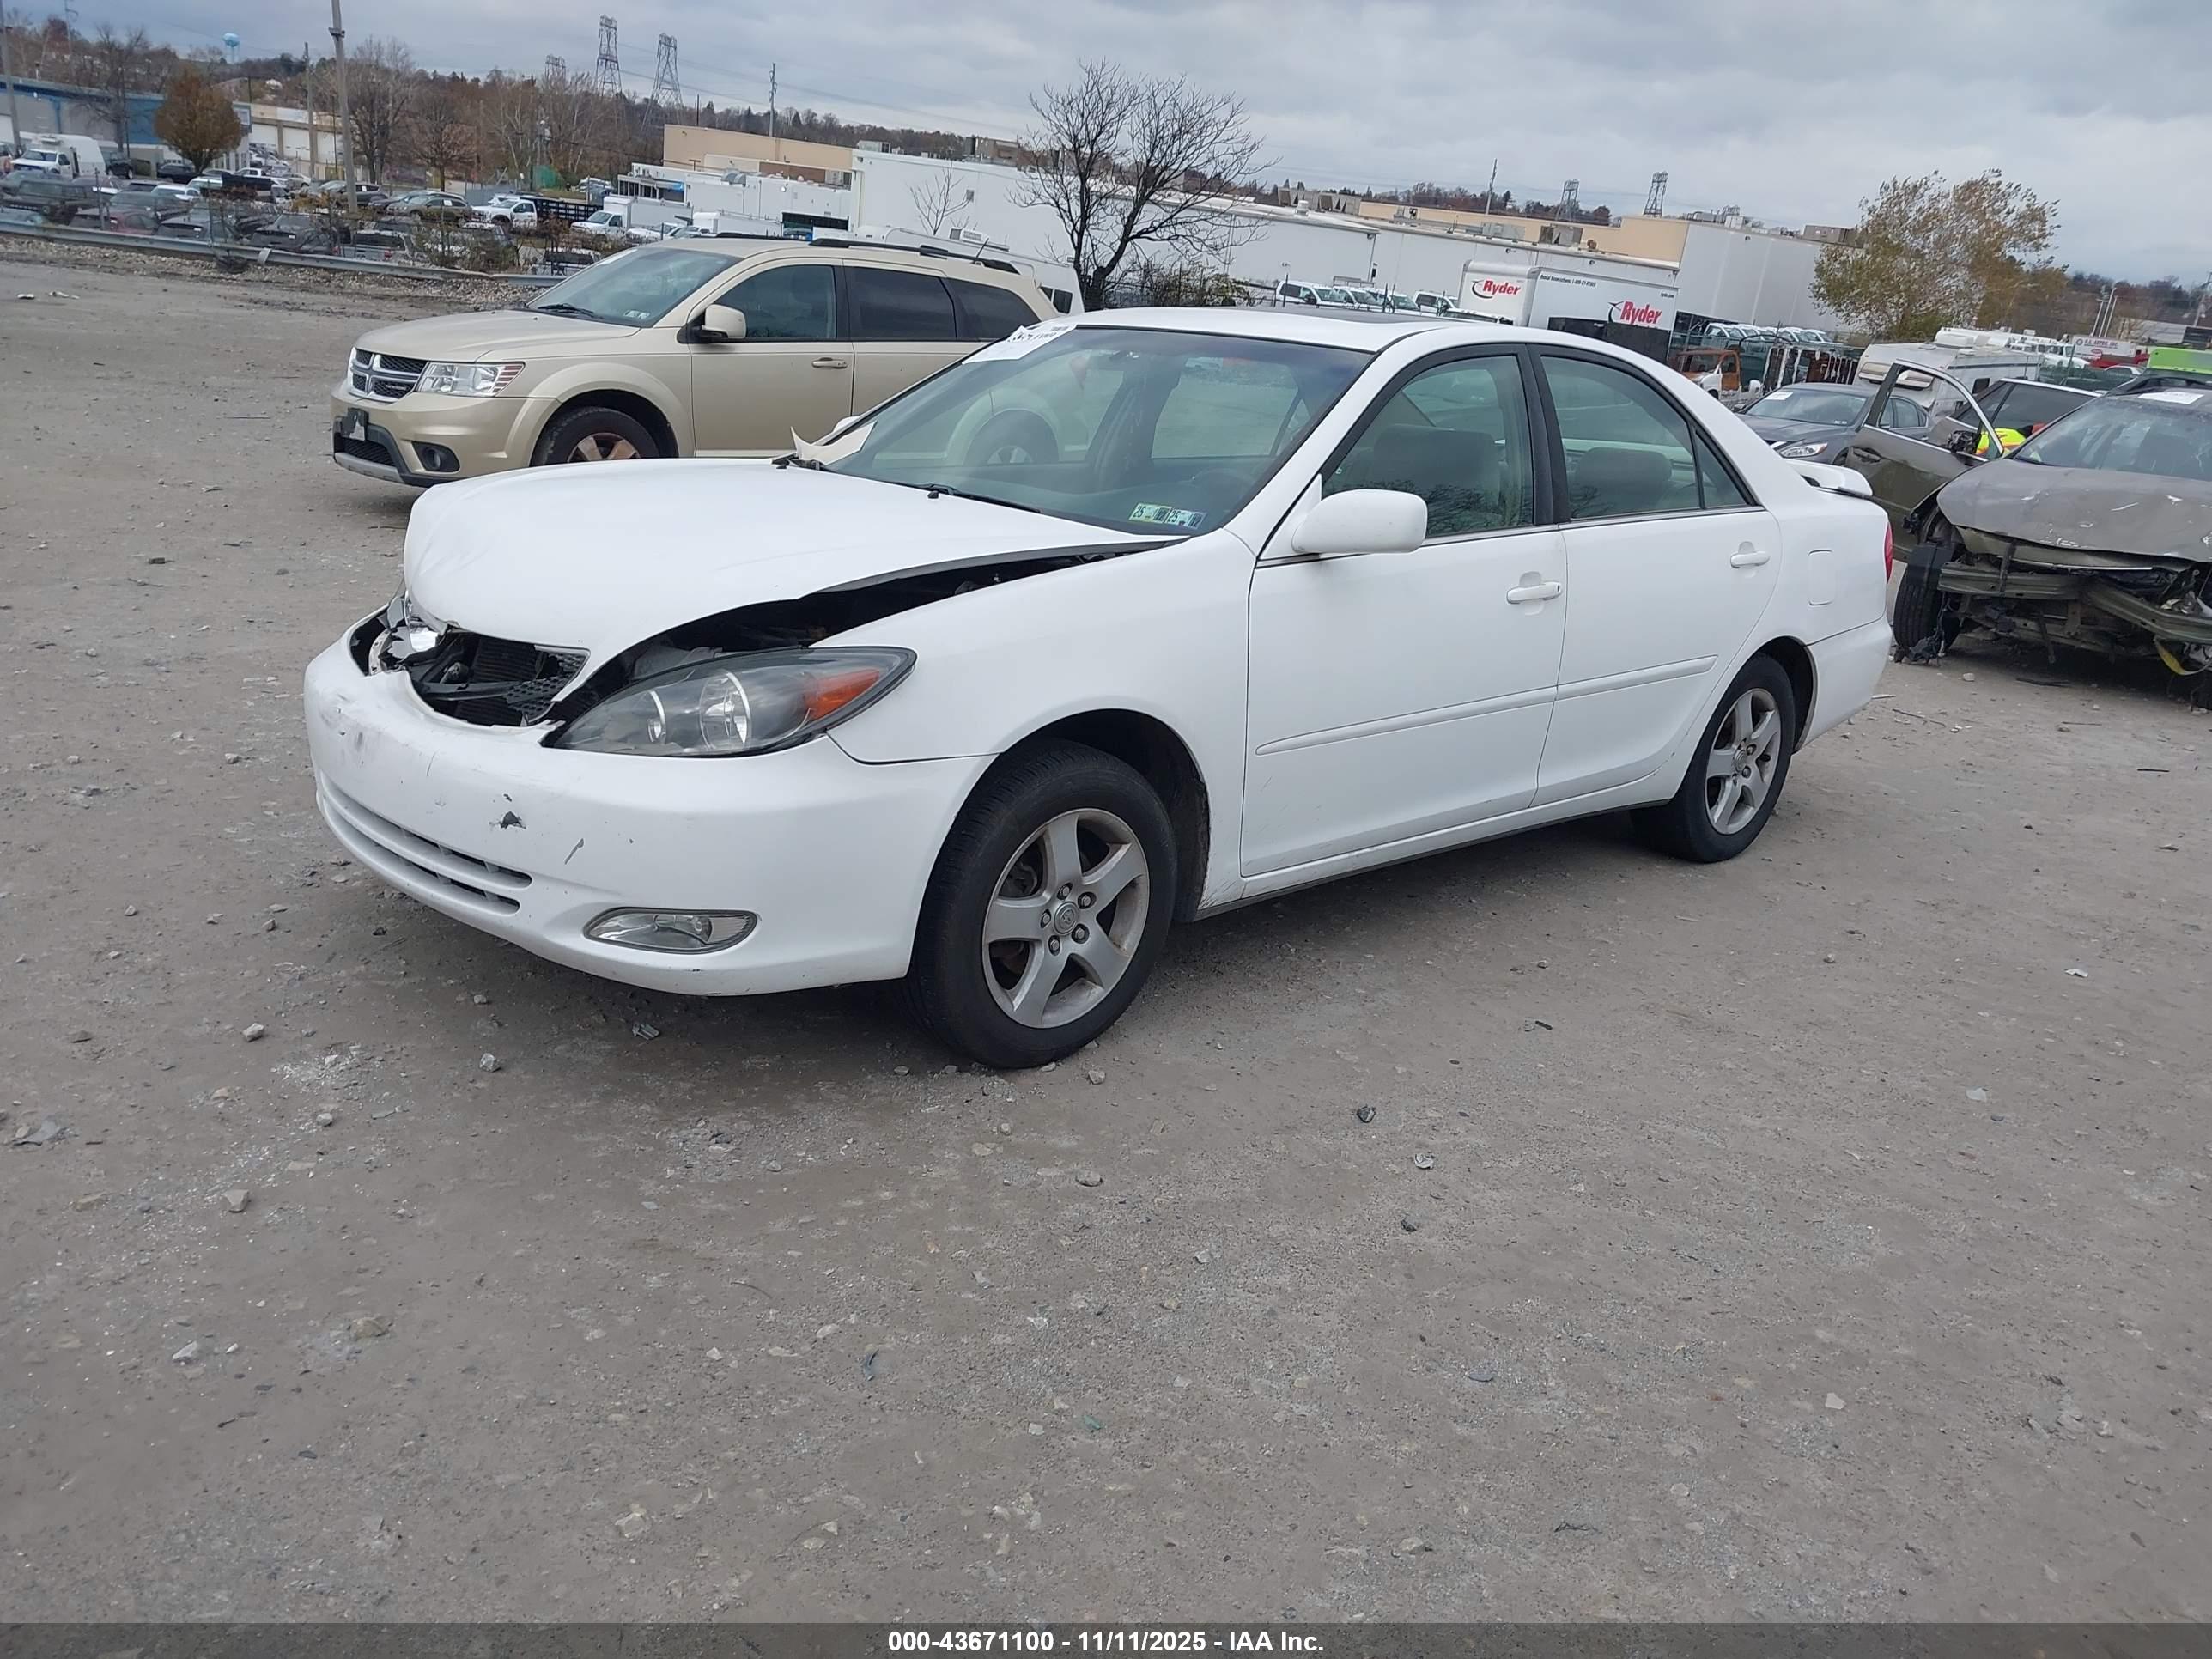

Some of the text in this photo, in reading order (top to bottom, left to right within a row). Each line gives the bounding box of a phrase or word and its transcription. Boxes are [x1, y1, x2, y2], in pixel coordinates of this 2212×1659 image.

[1482, 280, 1521, 295] Ryder
[1620, 301, 1662, 325] Ryder
[1133, 505, 1146, 518] 25
[1168, 510, 1181, 523] 25
